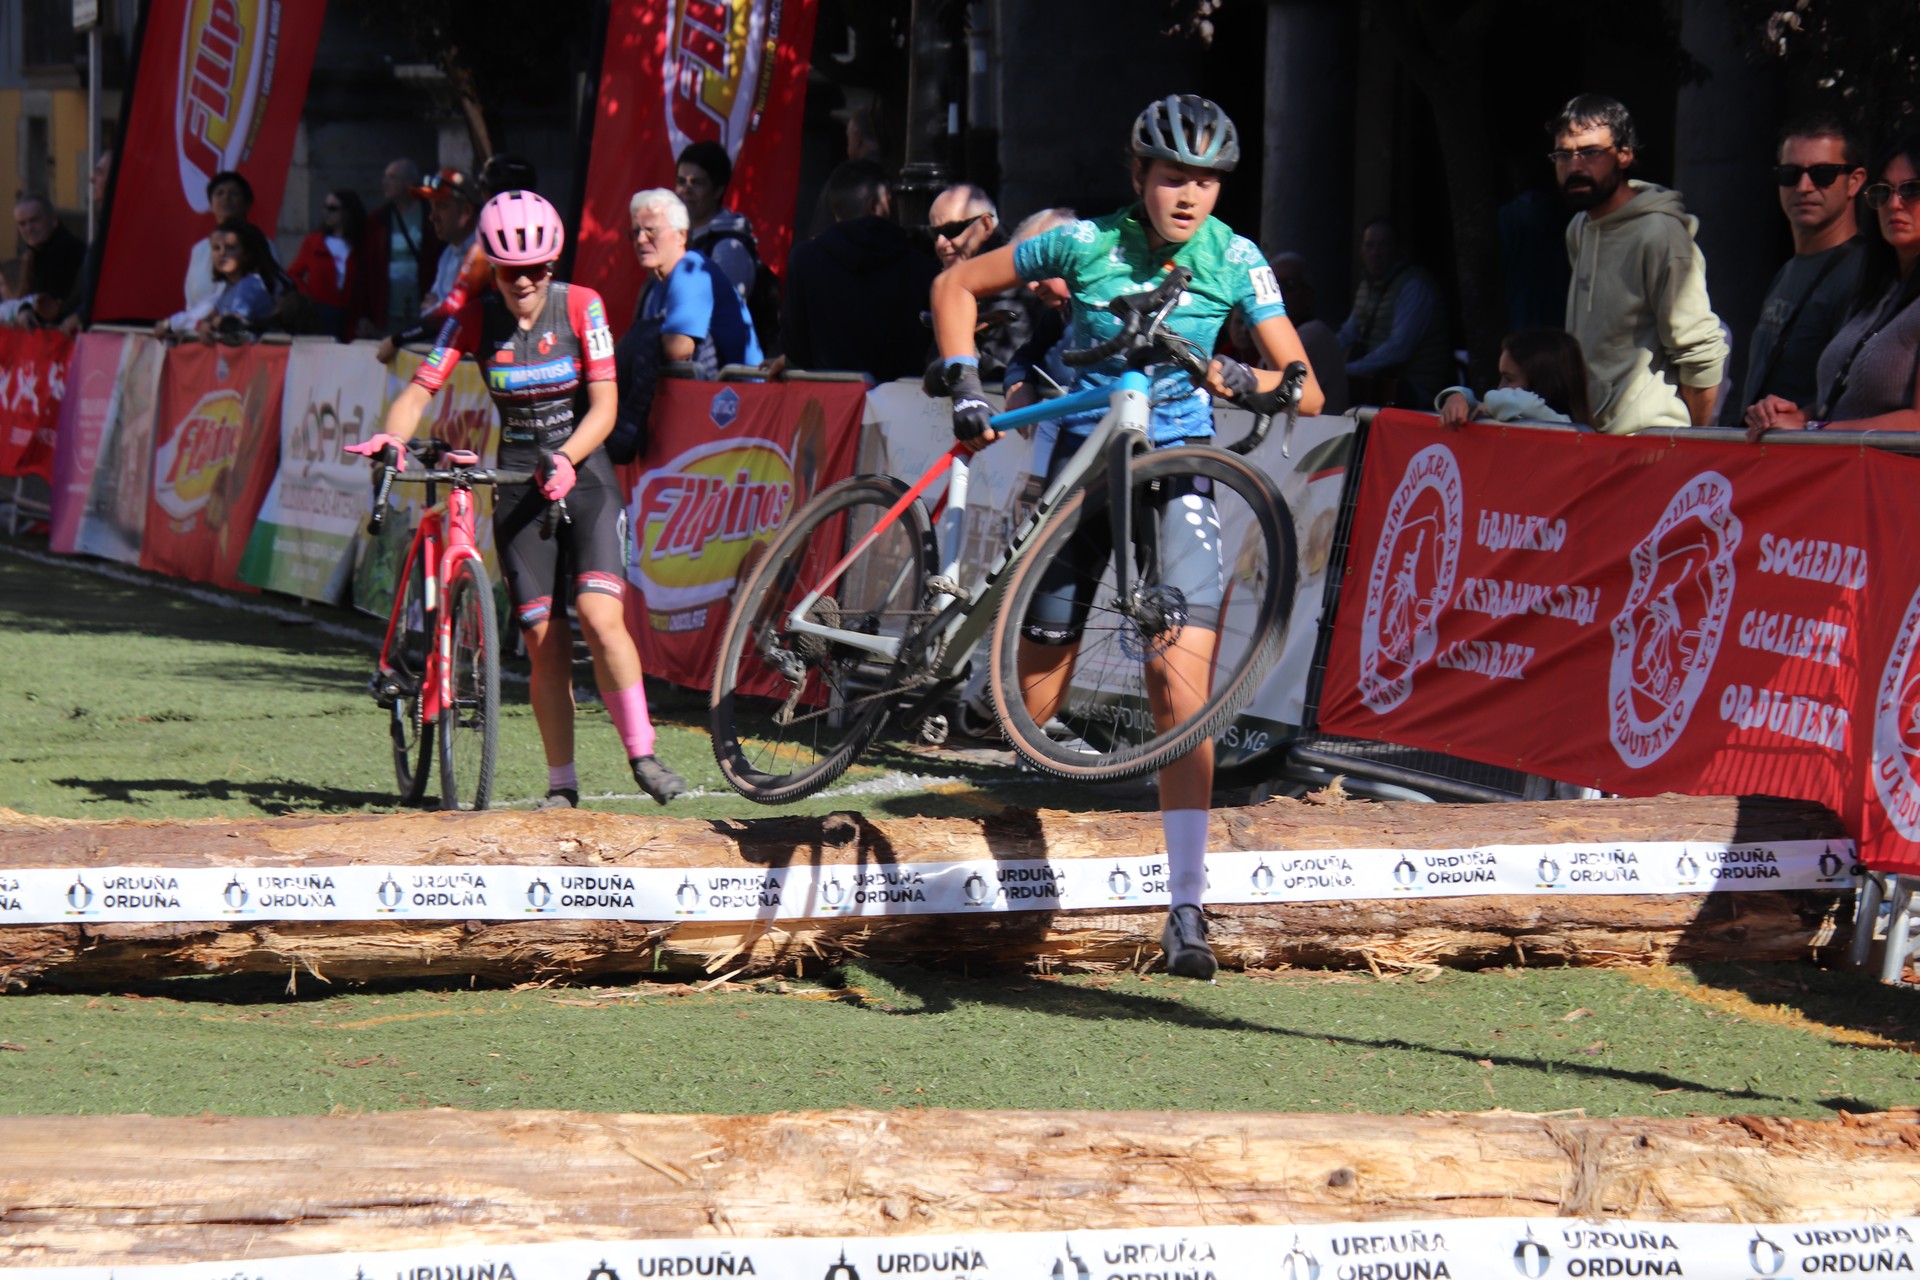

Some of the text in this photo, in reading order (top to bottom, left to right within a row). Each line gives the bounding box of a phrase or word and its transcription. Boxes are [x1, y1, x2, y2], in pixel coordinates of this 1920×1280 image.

[1706, 847, 1778, 864] URDUÑA
[637, 1250, 757, 1277] URDUÑA
[876, 1246, 988, 1274] URDUÑA
[1336, 1258, 1451, 1280] ORDUÑA
[1566, 1252, 1684, 1278] ORDUÑA
[1801, 1249, 1915, 1274] ORDUÑA
